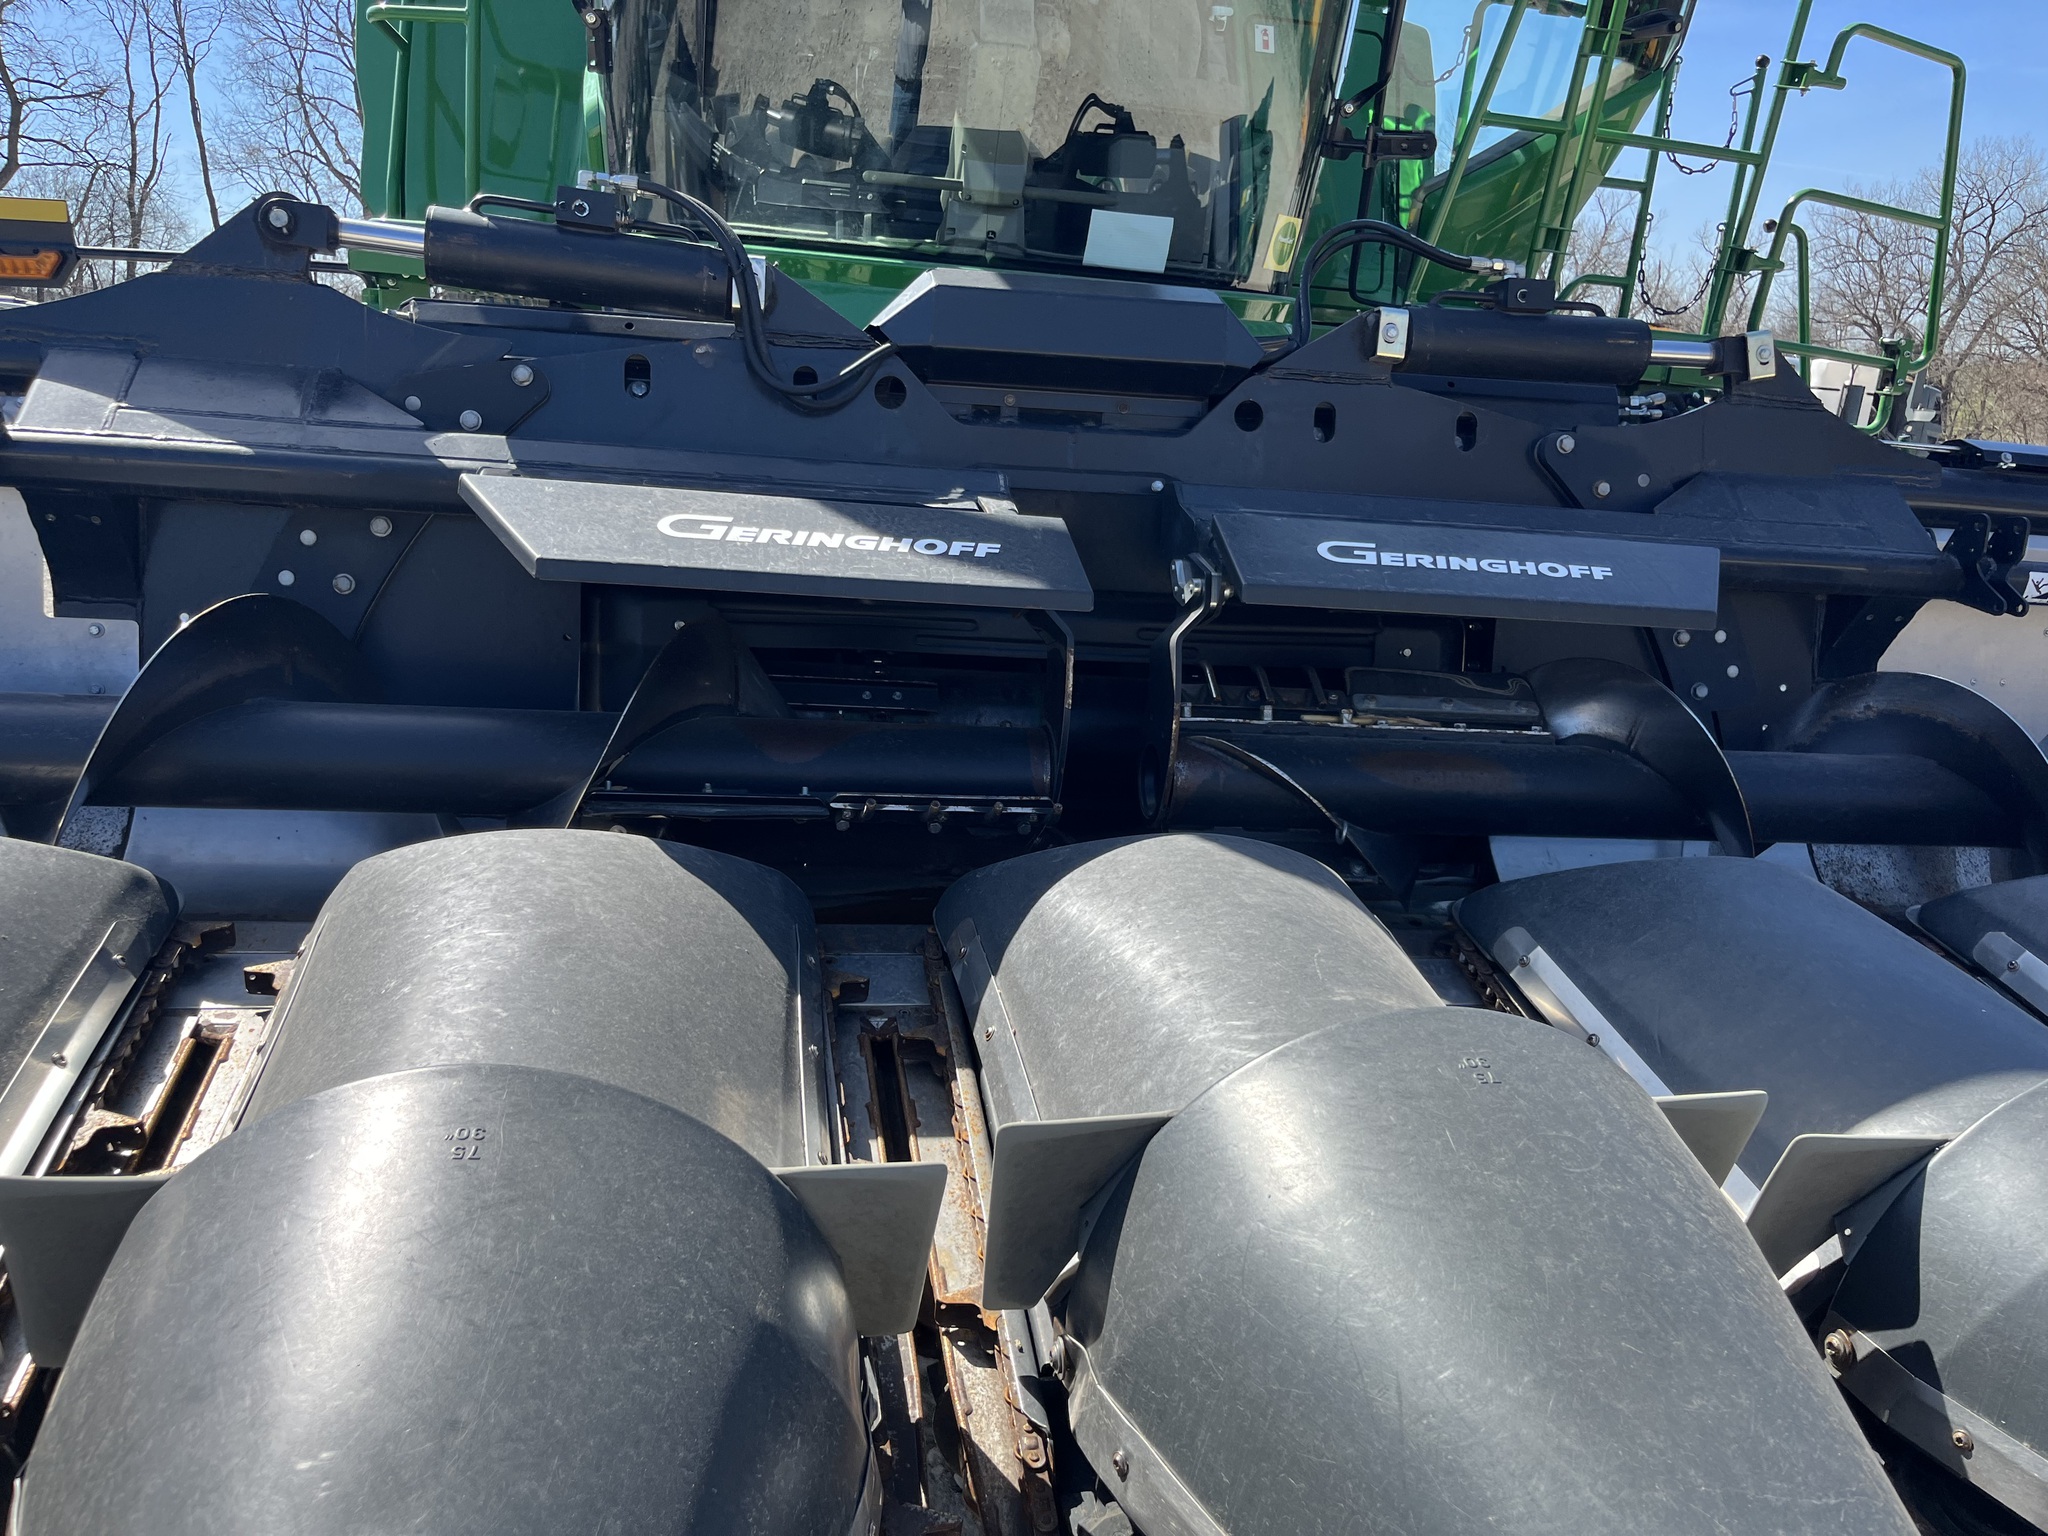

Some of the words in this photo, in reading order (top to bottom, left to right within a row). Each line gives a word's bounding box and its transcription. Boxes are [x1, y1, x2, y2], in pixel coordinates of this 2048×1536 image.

[656, 513, 1002, 558] GERINGHOFF
[1316, 540, 1613, 580] GERINGHOFF
[1473, 1071, 1502, 1084] 75
[450, 1145, 481, 1160] 75
